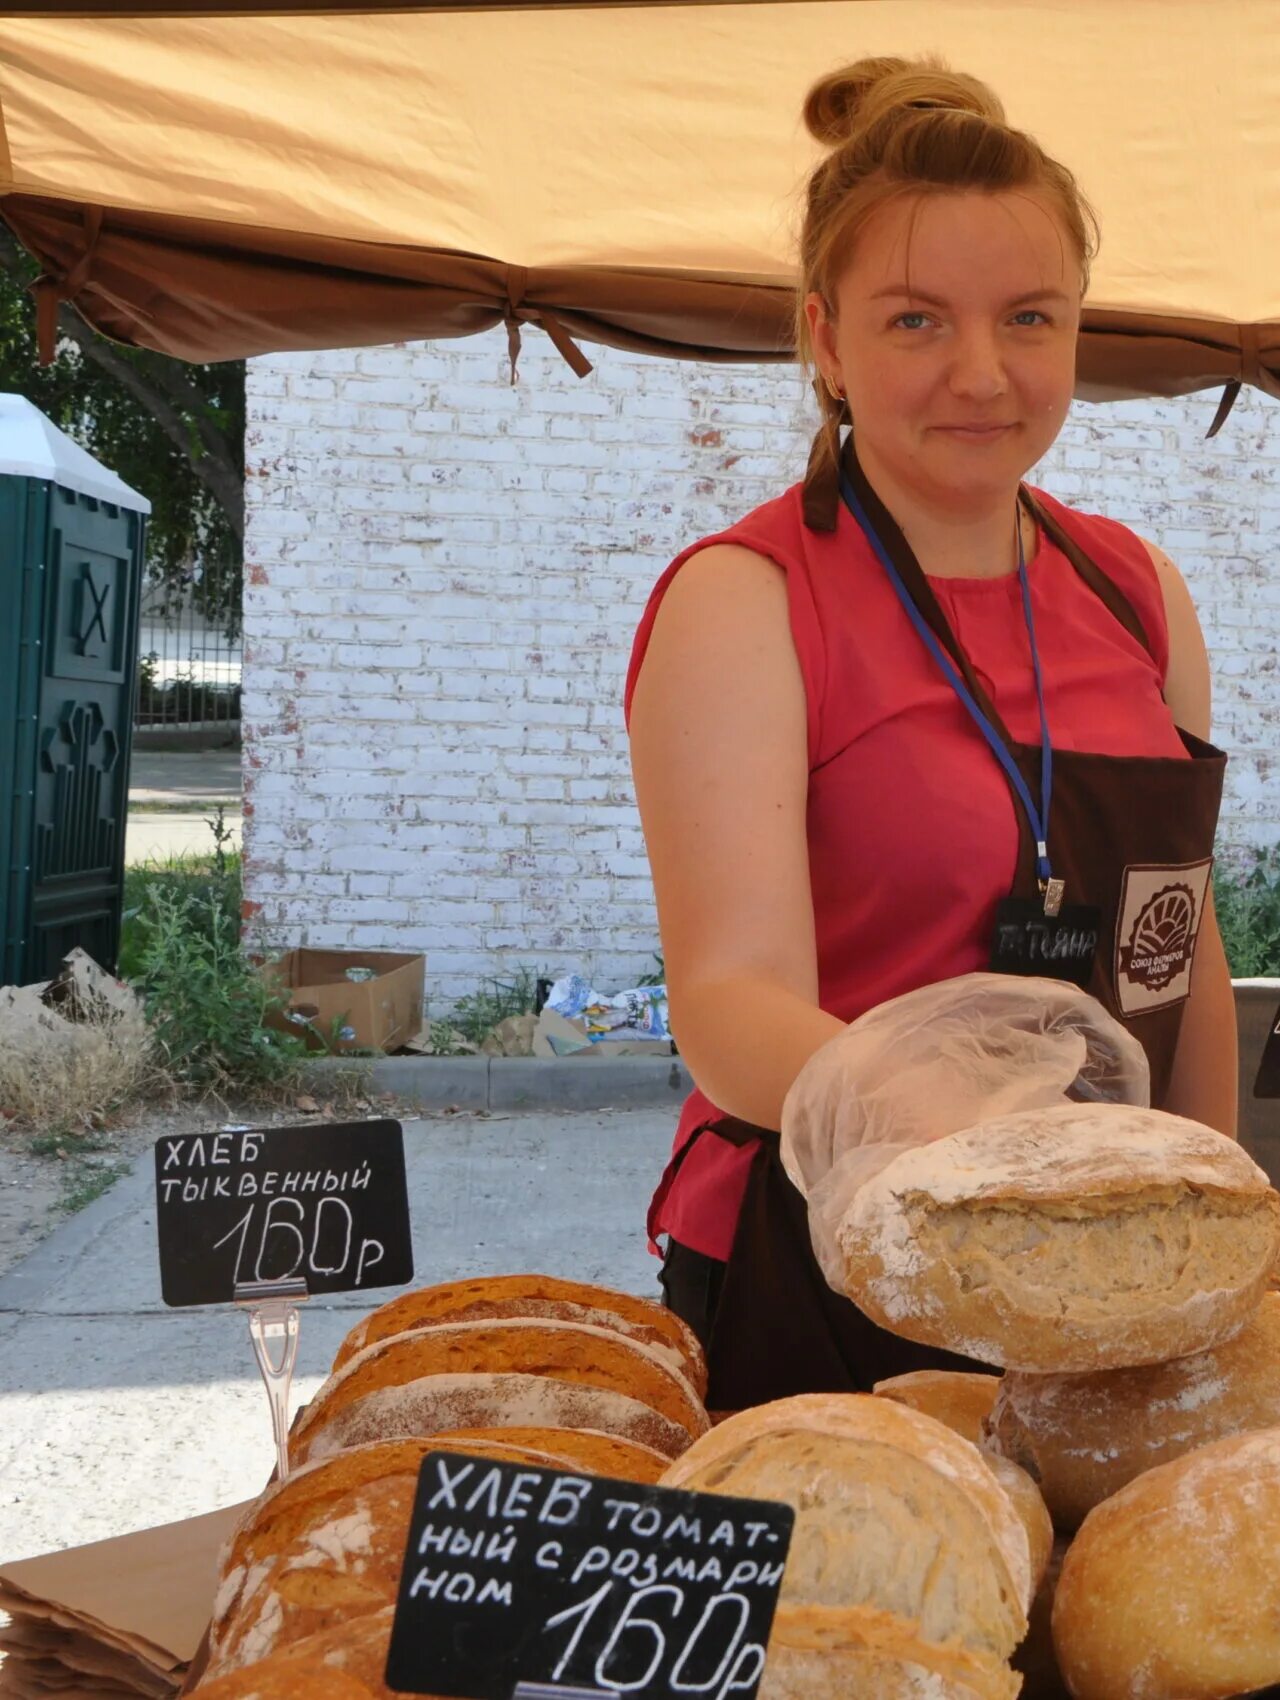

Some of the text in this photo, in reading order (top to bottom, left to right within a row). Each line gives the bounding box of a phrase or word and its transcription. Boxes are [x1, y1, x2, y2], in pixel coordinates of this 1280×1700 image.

[1131, 957, 1153, 969] СОЮЗ
[164, 1134, 264, 1170] ХЛЕБ
[161, 1160, 371, 1203] ТЫКВЕННЫЙ
[428, 1459, 592, 1525] ХЛЕБ
